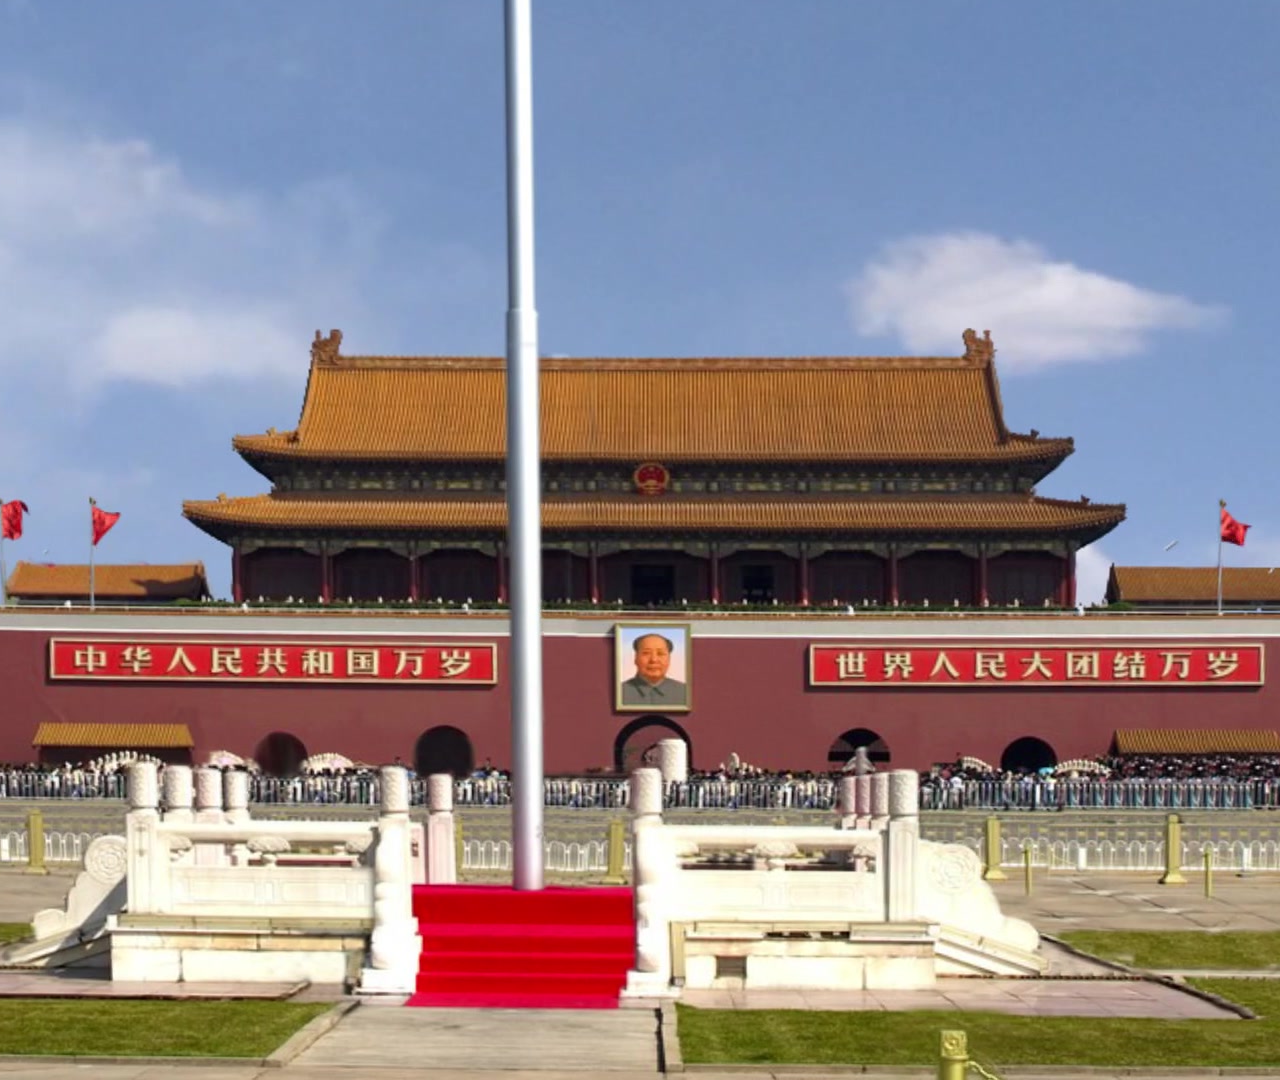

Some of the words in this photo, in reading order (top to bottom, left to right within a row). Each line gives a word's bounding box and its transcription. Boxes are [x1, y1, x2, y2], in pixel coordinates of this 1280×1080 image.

[74, 646, 472, 677] 中华人民共和国万岁
[835, 651, 1240, 679] 世界人民大团结万岁
